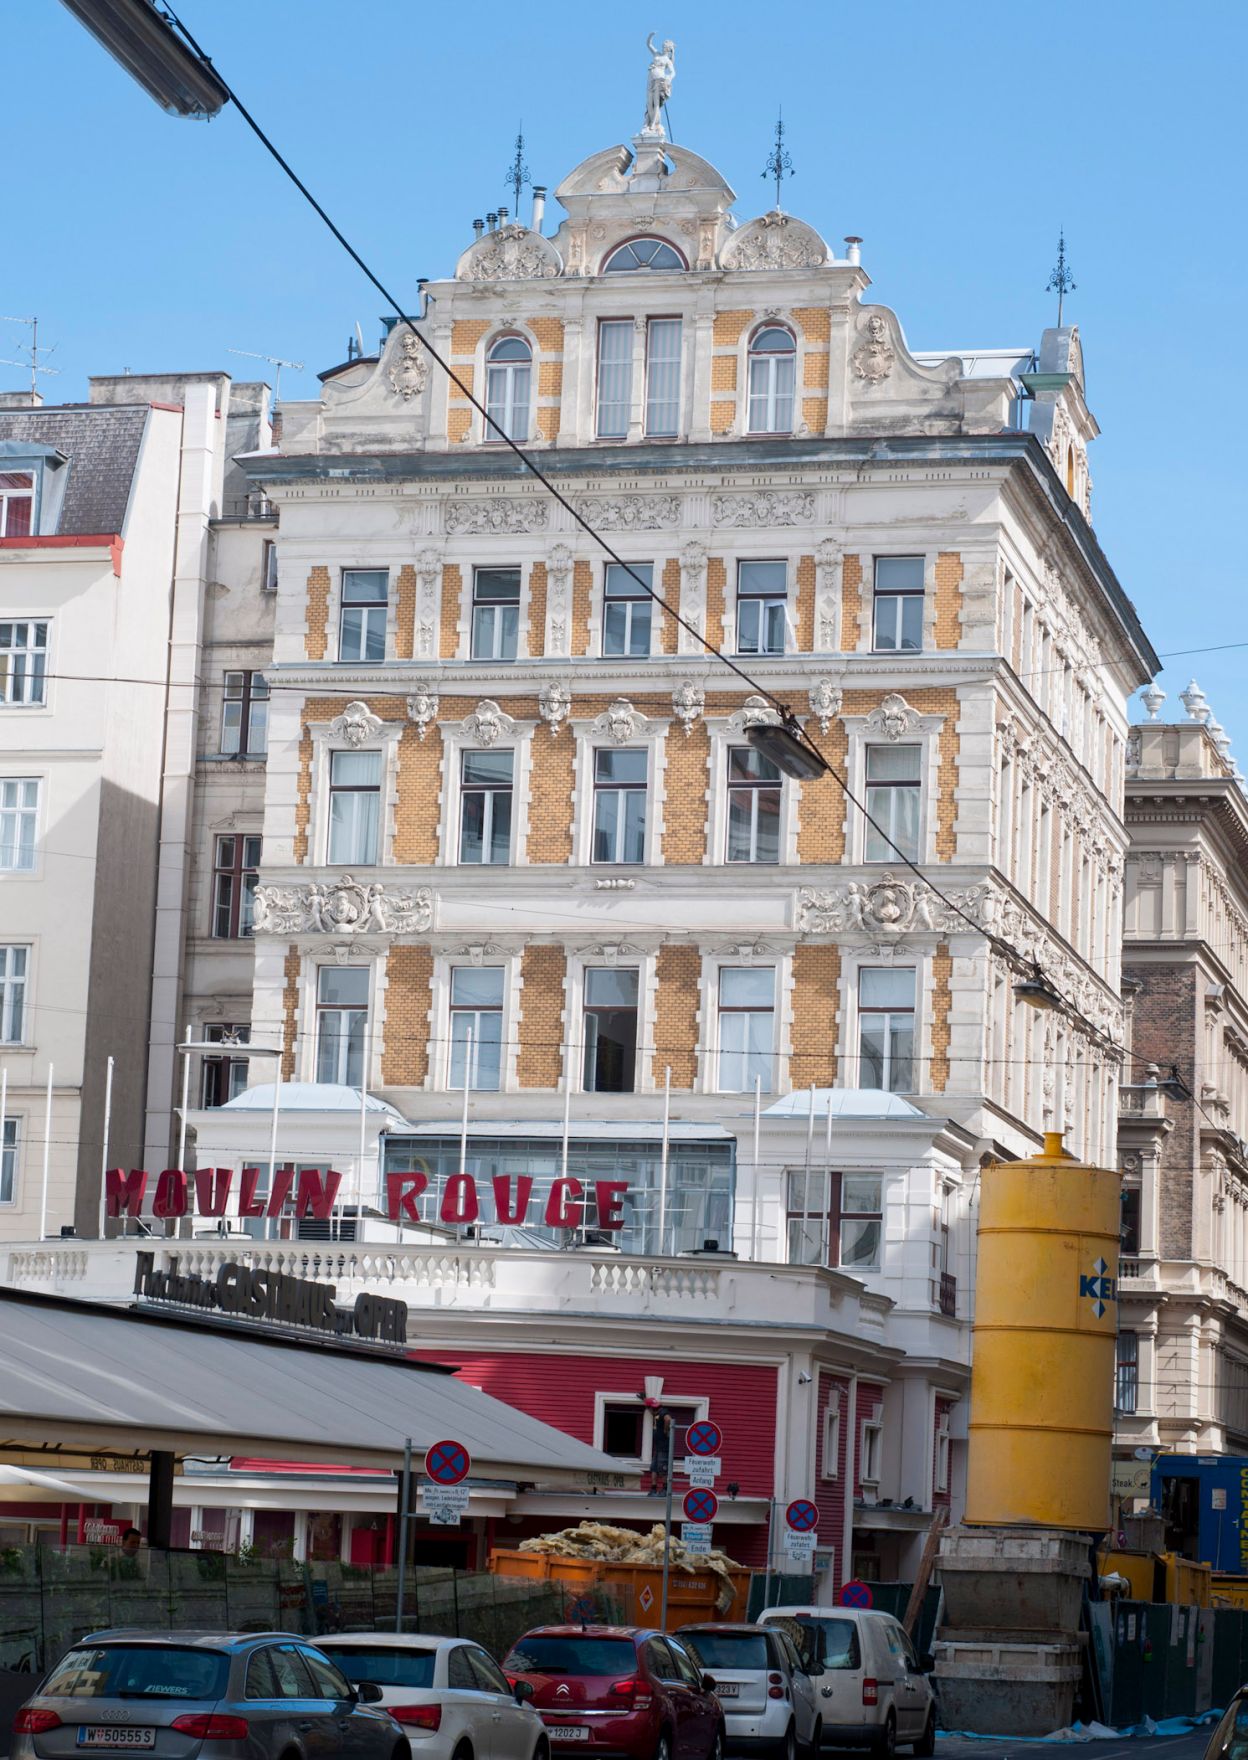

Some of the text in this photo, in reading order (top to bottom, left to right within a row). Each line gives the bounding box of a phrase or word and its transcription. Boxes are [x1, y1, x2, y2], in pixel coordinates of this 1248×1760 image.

[106, 1168, 630, 1230] MOULIN ROUGE
[216, 1262, 336, 1332] GASTHAUS
[354, 1292, 408, 1343] OPER
[692, 1476, 712, 1487] Anfang
[690, 1544, 707, 1553] Ende
[88, 1728, 96, 1741] W
[105, 1729, 142, 1743] 50555
